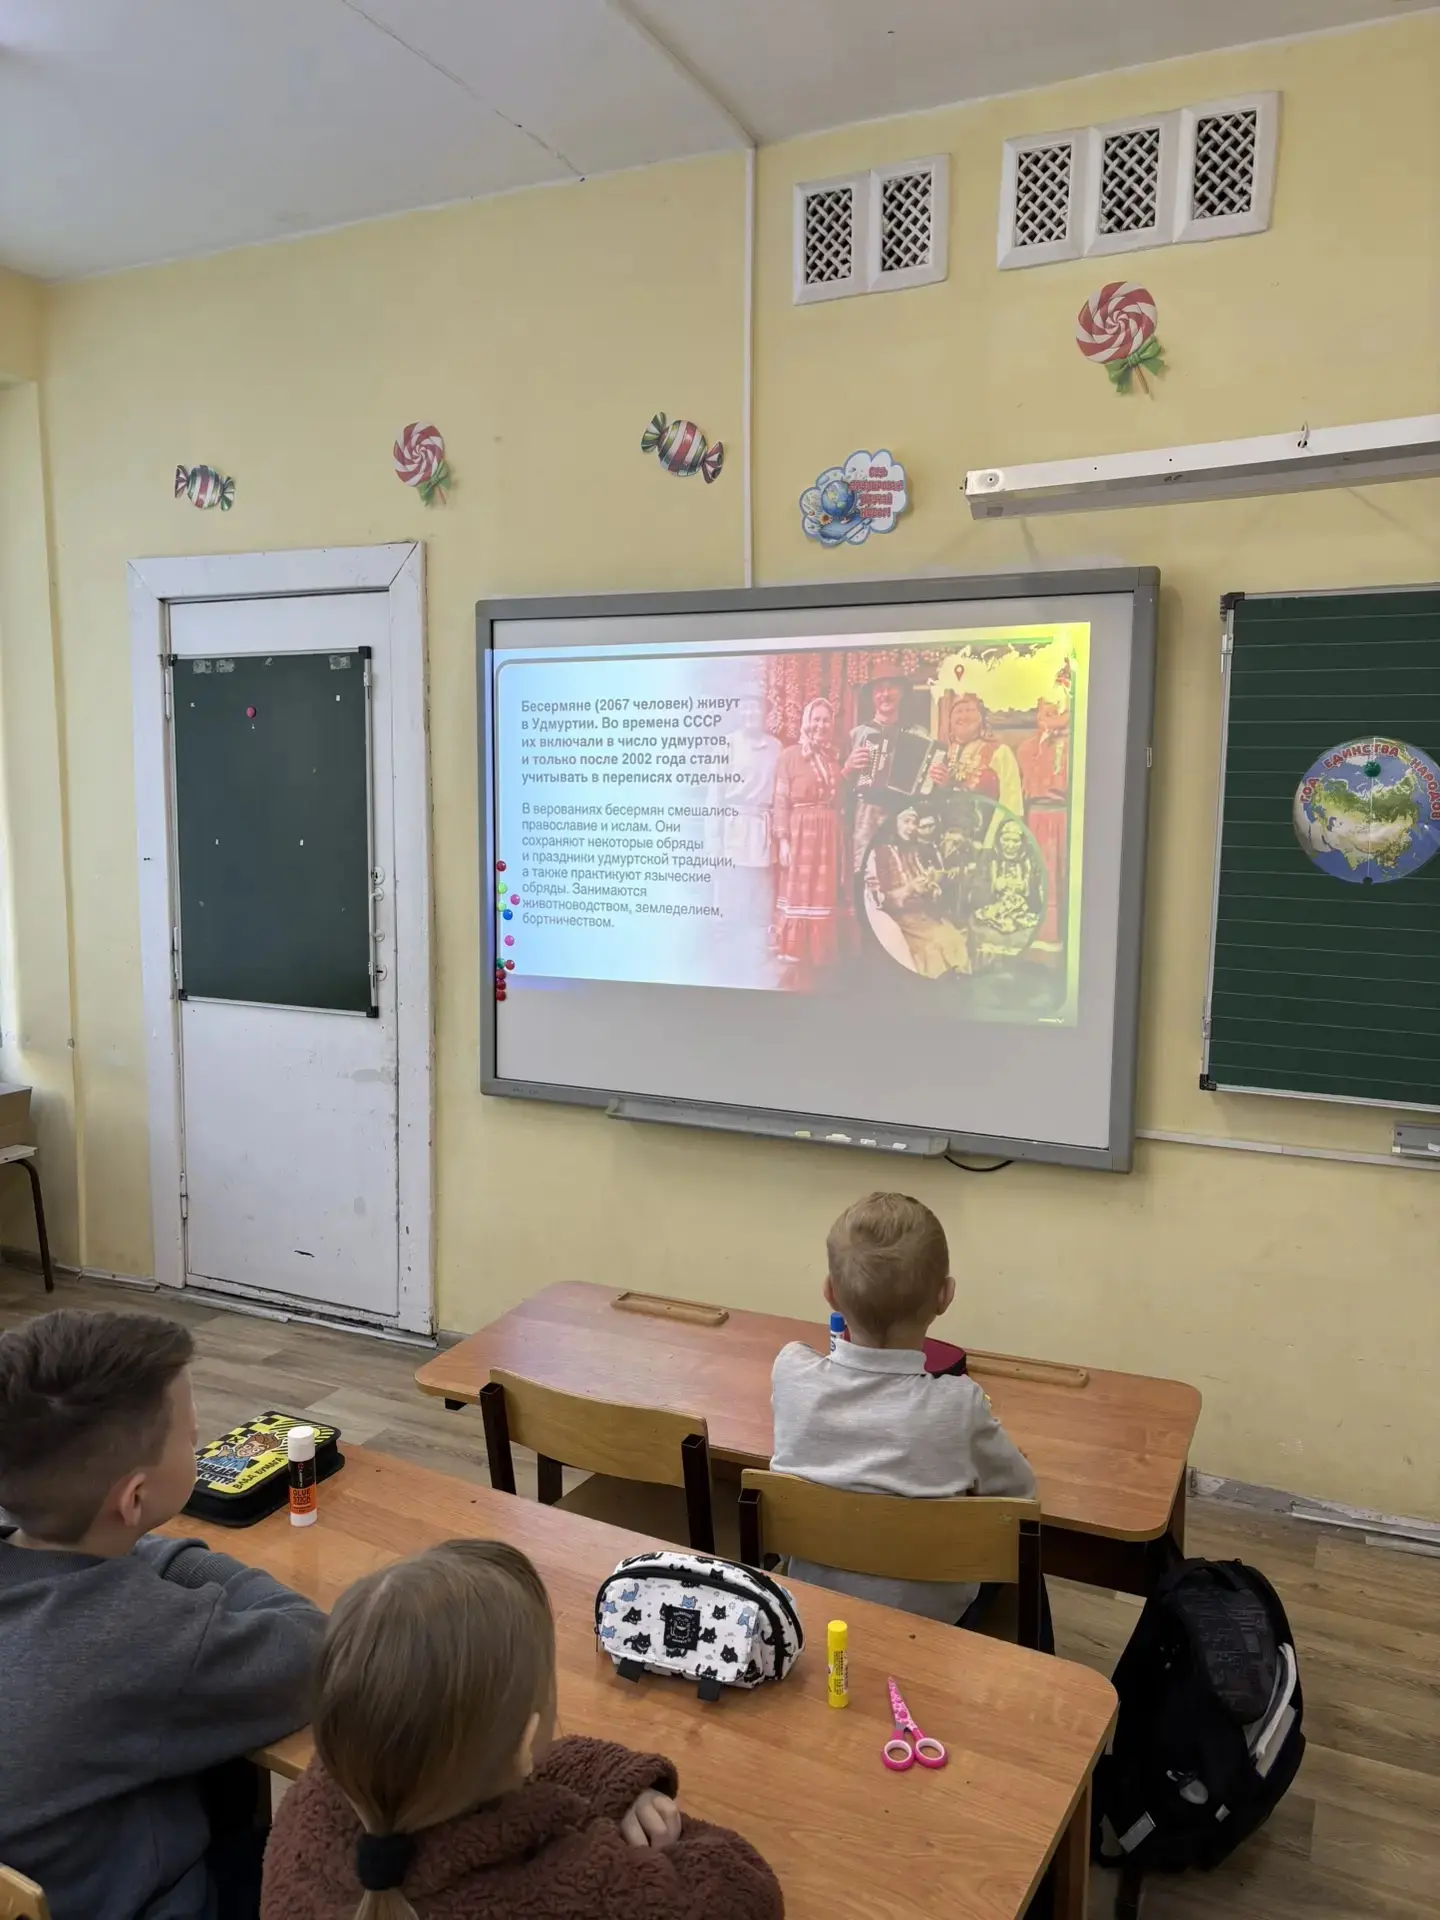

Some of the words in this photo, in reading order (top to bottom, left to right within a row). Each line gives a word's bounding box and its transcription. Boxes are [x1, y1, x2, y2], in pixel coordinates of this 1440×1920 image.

[521, 701, 591, 715] Бесермяне
[594, 698, 630, 714] (2067
[633, 696, 694, 711] человек)
[697, 698, 740, 714] живут
[521, 722, 529, 730] в
[531, 719, 599, 732] Удмуртии.
[601, 717, 619, 729] Во
[623, 719, 679, 731] времена
[683, 715, 722, 728] СССР
[522, 738, 536, 747] их
[540, 737, 603, 747] включали
[607, 737, 614, 746] в
[618, 736, 657, 747] число
[661, 736, 730, 750] удмуртов,
[522, 756, 529, 765] и
[533, 756, 576, 765] только
[580, 755, 618, 765] после
[621, 753, 652, 765] 2002
[656, 755, 686, 767] года
[689, 753, 729, 764] стали
[522, 773, 588, 786] учитывать
[592, 774, 600, 783] в
[602, 772, 672, 786] переписях
[676, 772, 745, 786] отдельно.
[1300, 776, 1319, 804] ГОД
[1323, 743, 1399, 769] ЕДИНСТВА
[1409, 757, 1440, 819] НАРОДОВ
[522, 803, 530, 814] В
[533, 805, 602, 817] верованиях
[605, 804, 664, 819] бесермян
[668, 806, 739, 816] смешались
[522, 820, 597, 833] православие
[601, 821, 608, 831] и
[611, 821, 652, 832] ислам.
[655, 820, 681, 832] Они
[522, 836, 585, 849] сохраняют
[588, 838, 653, 851] некоторые
[656, 836, 704, 852] обряды
[522, 852, 529, 861] и
[532, 853, 595, 865] праздники
[597, 853, 669, 867] удмуртской
[672, 856, 736, 869] традиции,
[522, 869, 529, 877] а
[532, 869, 568, 878] также
[571, 870, 641, 884] практикуют
[644, 872, 711, 883] языческие
[522, 882, 569, 897] обряды.
[572, 883, 647, 897] Занимаются
[522, 899, 632, 915] животноводством,
[635, 903, 724, 919] земледелием,
[522, 913, 615, 928] бортничеством.
